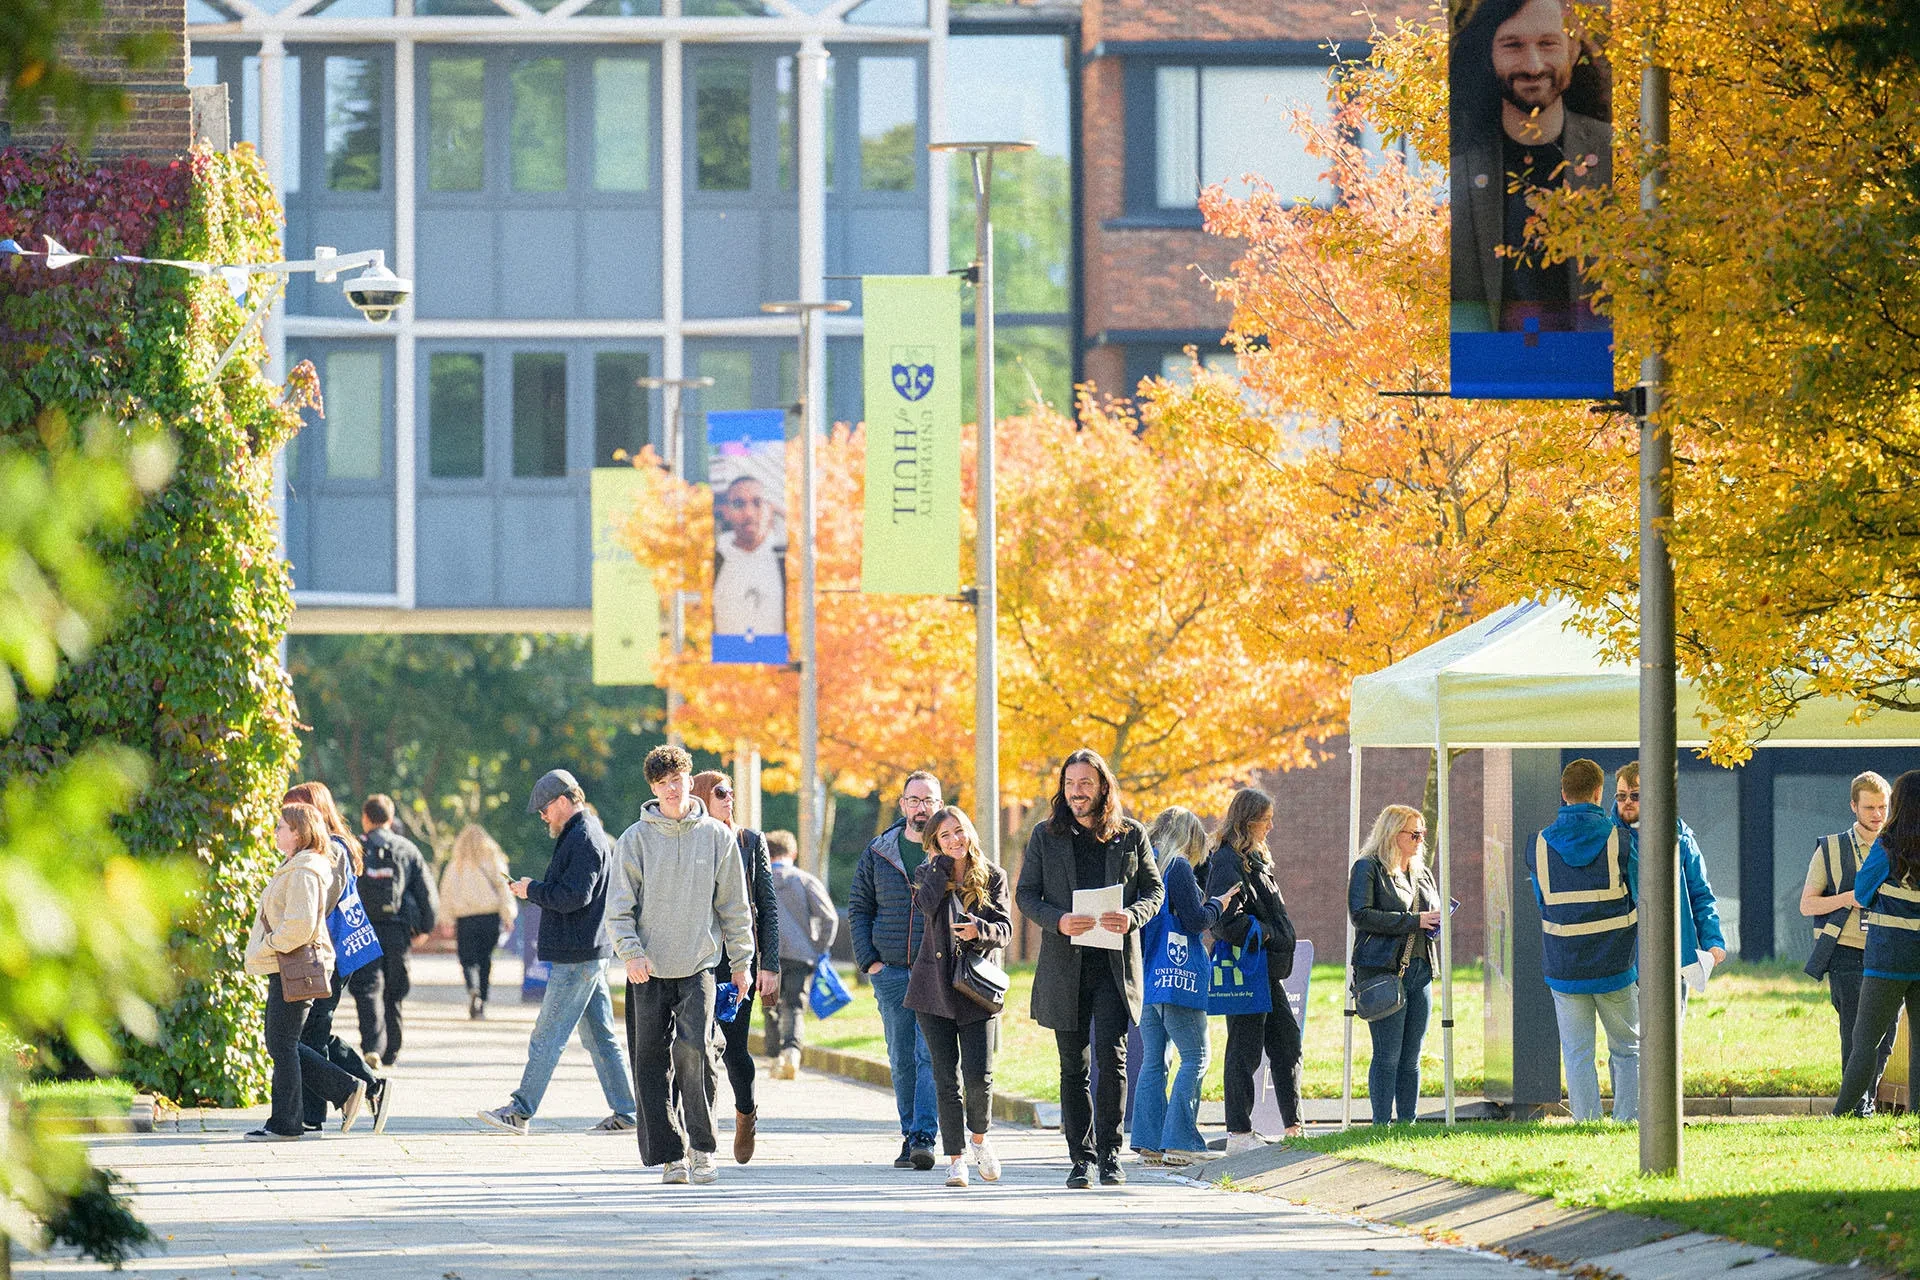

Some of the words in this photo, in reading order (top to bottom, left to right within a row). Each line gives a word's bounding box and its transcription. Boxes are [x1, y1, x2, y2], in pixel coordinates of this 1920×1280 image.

[894, 408, 914, 426] of
[920, 409, 934, 519] UNIVERSITY
[892, 426, 918, 525] HULL
[1155, 967, 1197, 980] UNIVERSITY
[1154, 978, 1162, 989] of
[1161, 974, 1198, 993] HULL
